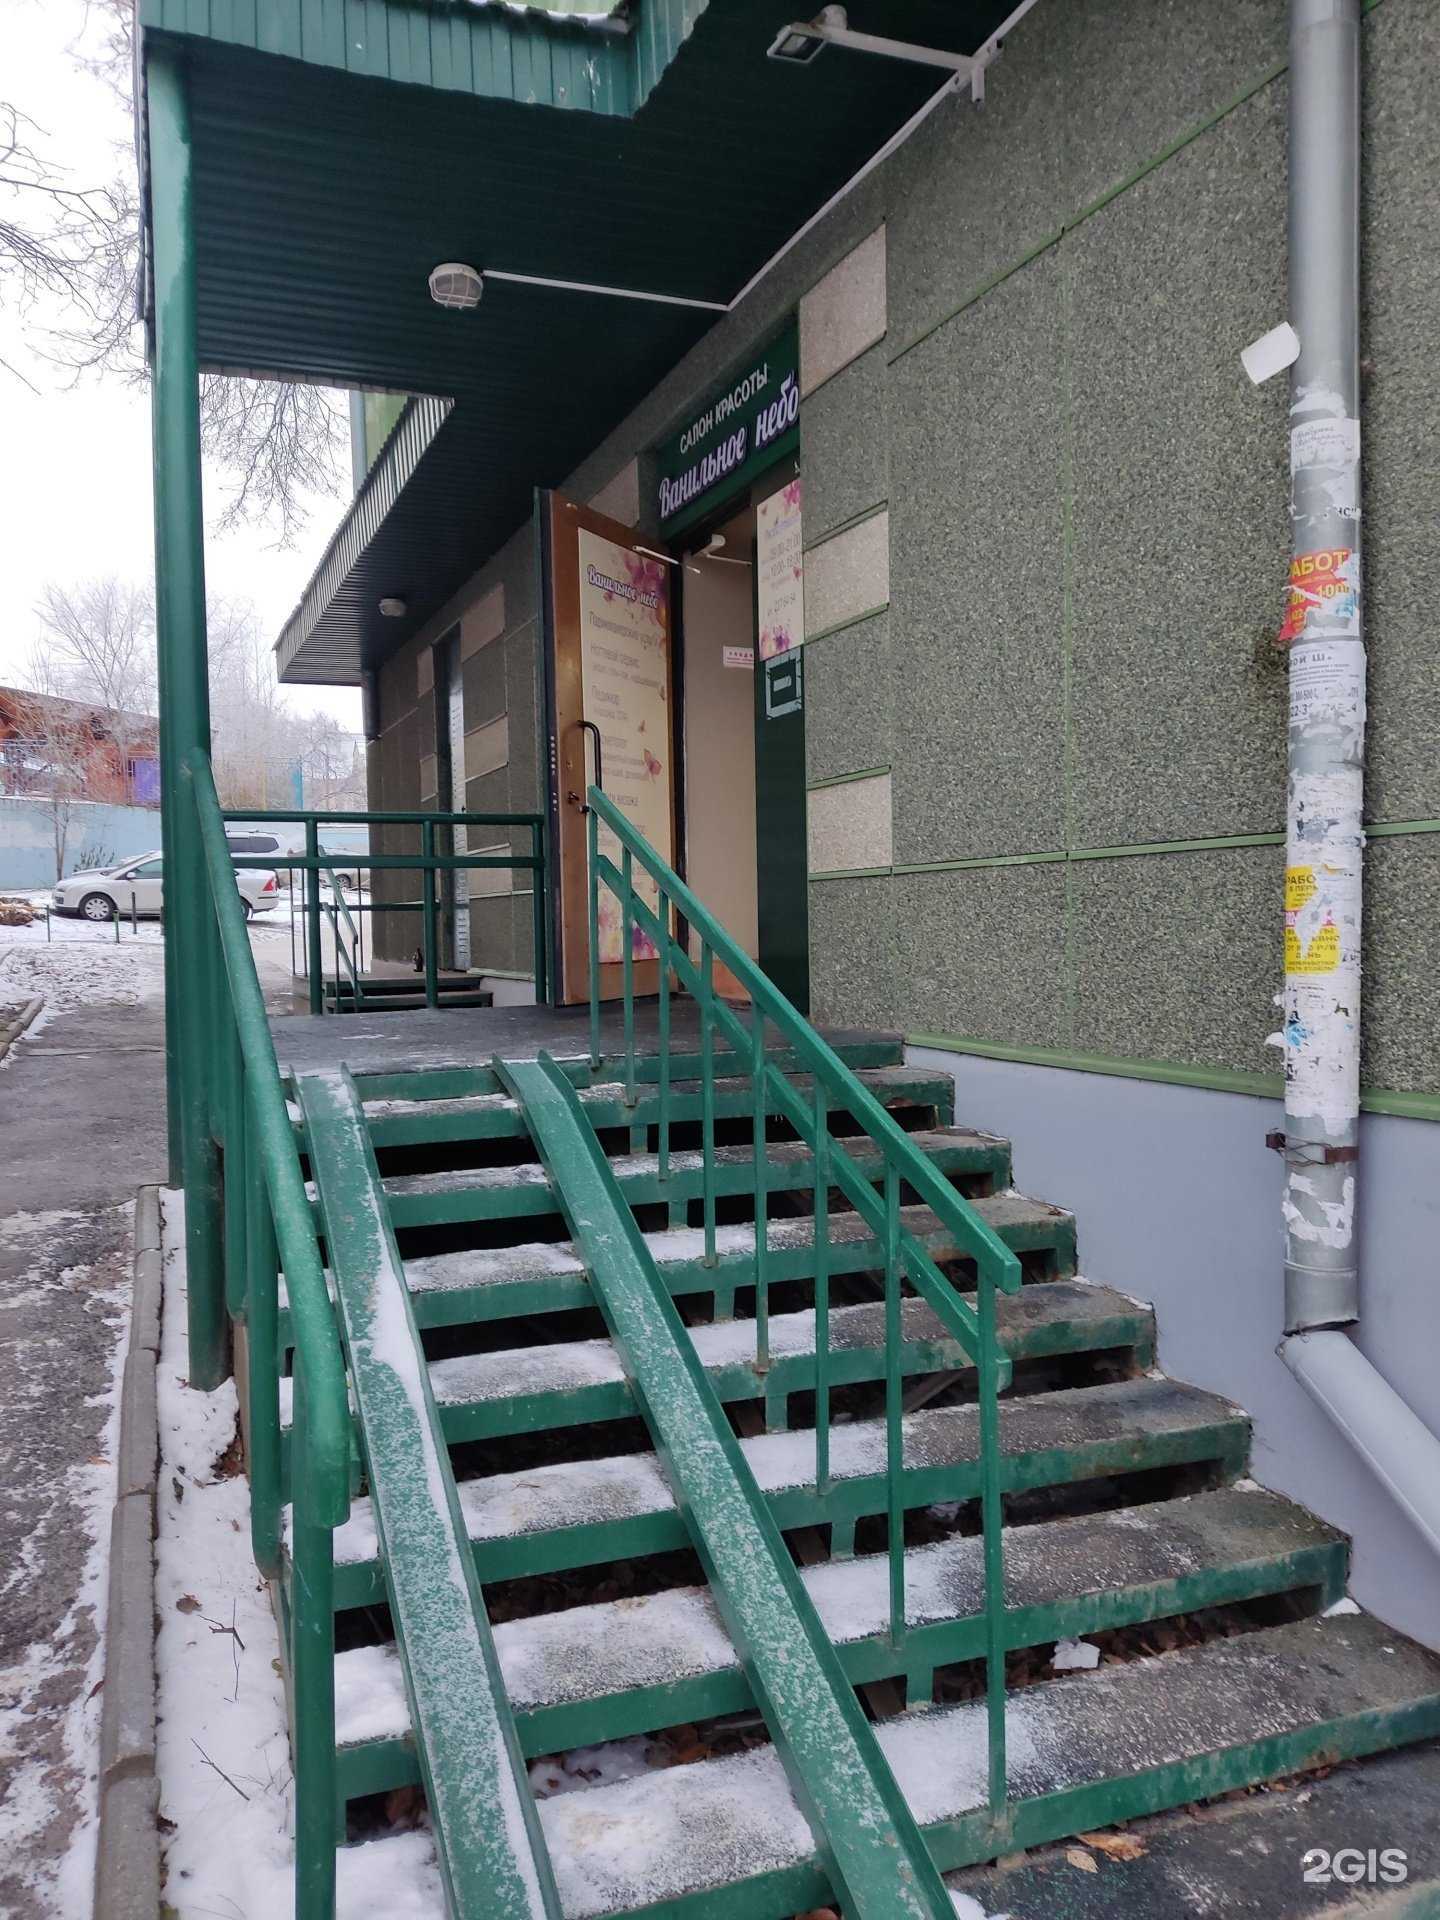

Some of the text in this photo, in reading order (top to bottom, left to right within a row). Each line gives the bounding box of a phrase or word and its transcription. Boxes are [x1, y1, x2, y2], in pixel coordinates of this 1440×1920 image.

[659, 371, 799, 519] Ванильное небо
[680, 362, 768, 454] САЛОН КРАСОТЫ
